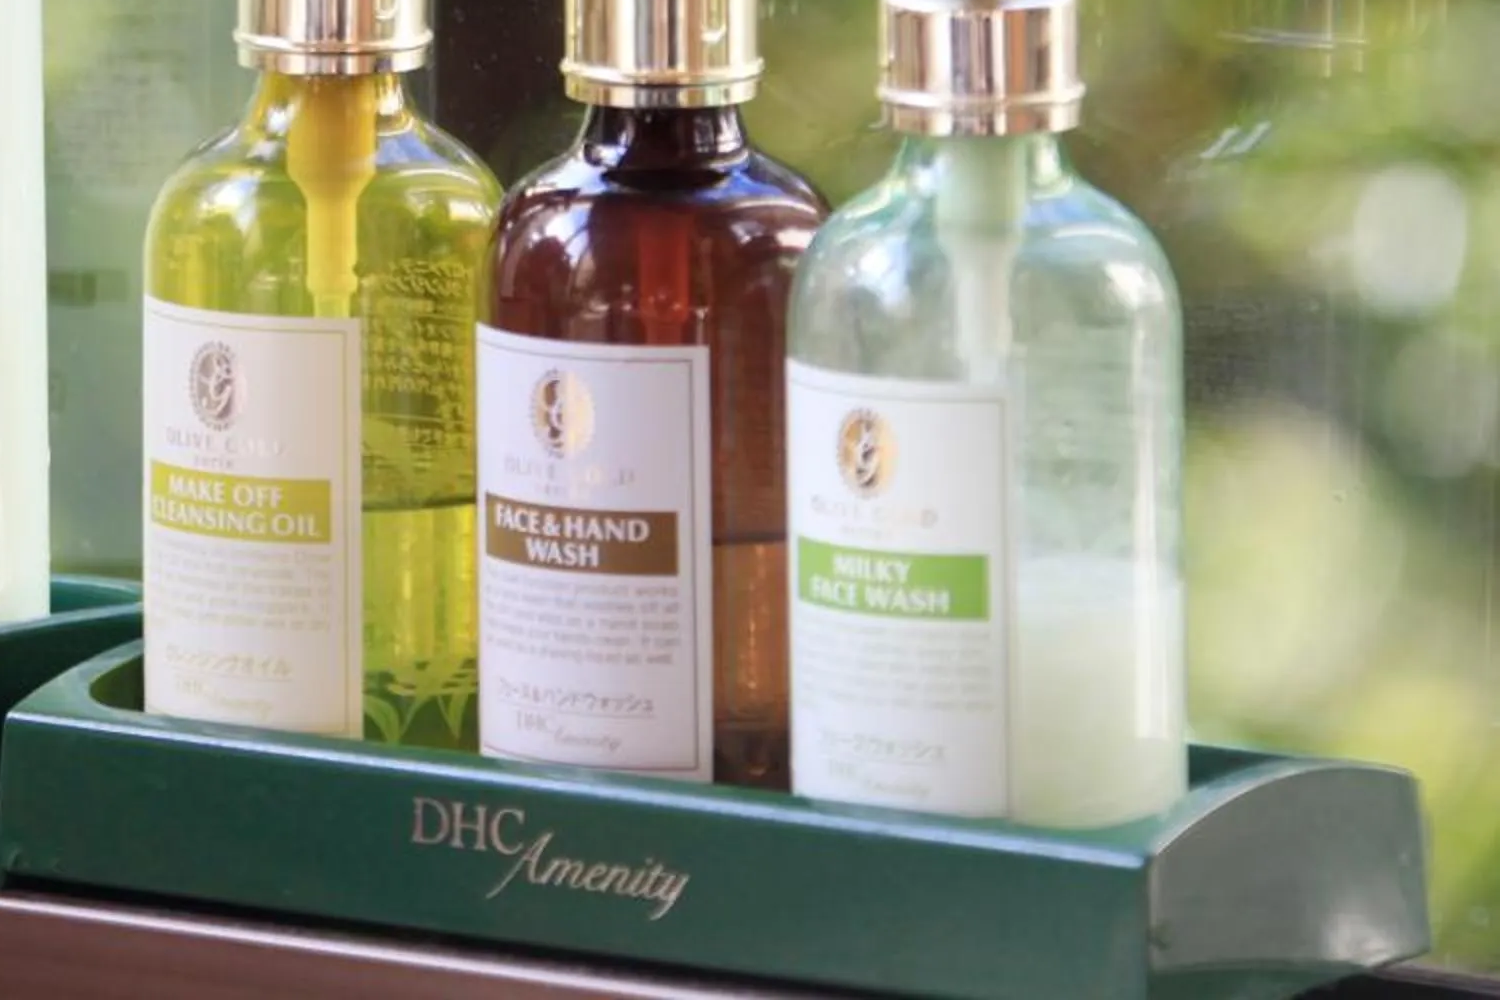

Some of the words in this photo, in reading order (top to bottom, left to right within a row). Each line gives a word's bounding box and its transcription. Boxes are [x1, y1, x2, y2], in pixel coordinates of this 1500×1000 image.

[168, 473, 226, 504] MAKE
[232, 482, 285, 509] OFF
[152, 496, 267, 537] CLEANSING
[270, 512, 321, 538] OIL
[524, 538, 600, 568] WASH
[832, 552, 913, 584] MILKY
[810, 573, 858, 608] FACE
[865, 586, 950, 615] WASH
[411, 796, 526, 856] DHC
[485, 832, 690, 921] Amenity
